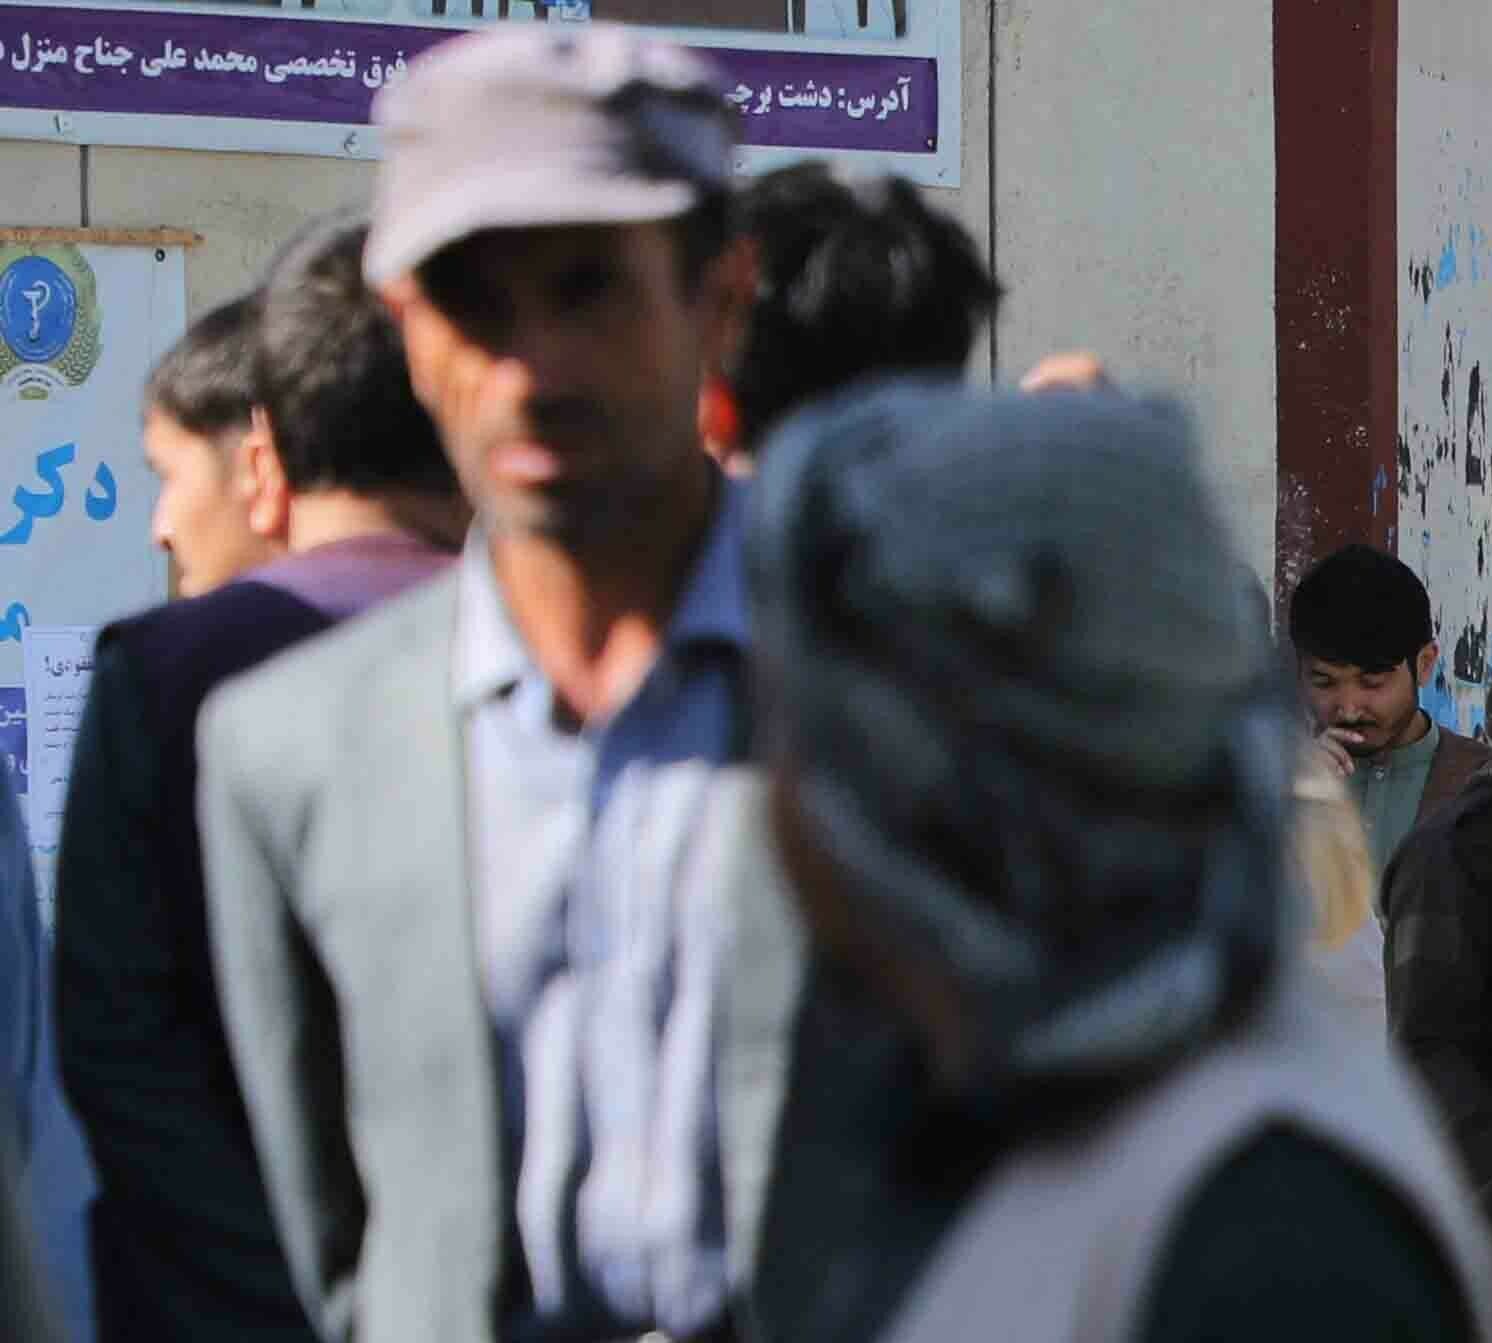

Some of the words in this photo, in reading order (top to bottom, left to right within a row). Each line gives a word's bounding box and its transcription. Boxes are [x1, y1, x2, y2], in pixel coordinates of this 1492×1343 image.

[11, 32, 67, 72] منزل
[74, 36, 134, 75] جناح
[141, 39, 187, 77] علی
[193, 48, 257, 73] محمد
[264, 49, 356, 84] تخصصی
[363, 51, 407, 89] فوق
[779, 80, 832, 108] دشت
[838, 76, 911, 119] آدرس:
